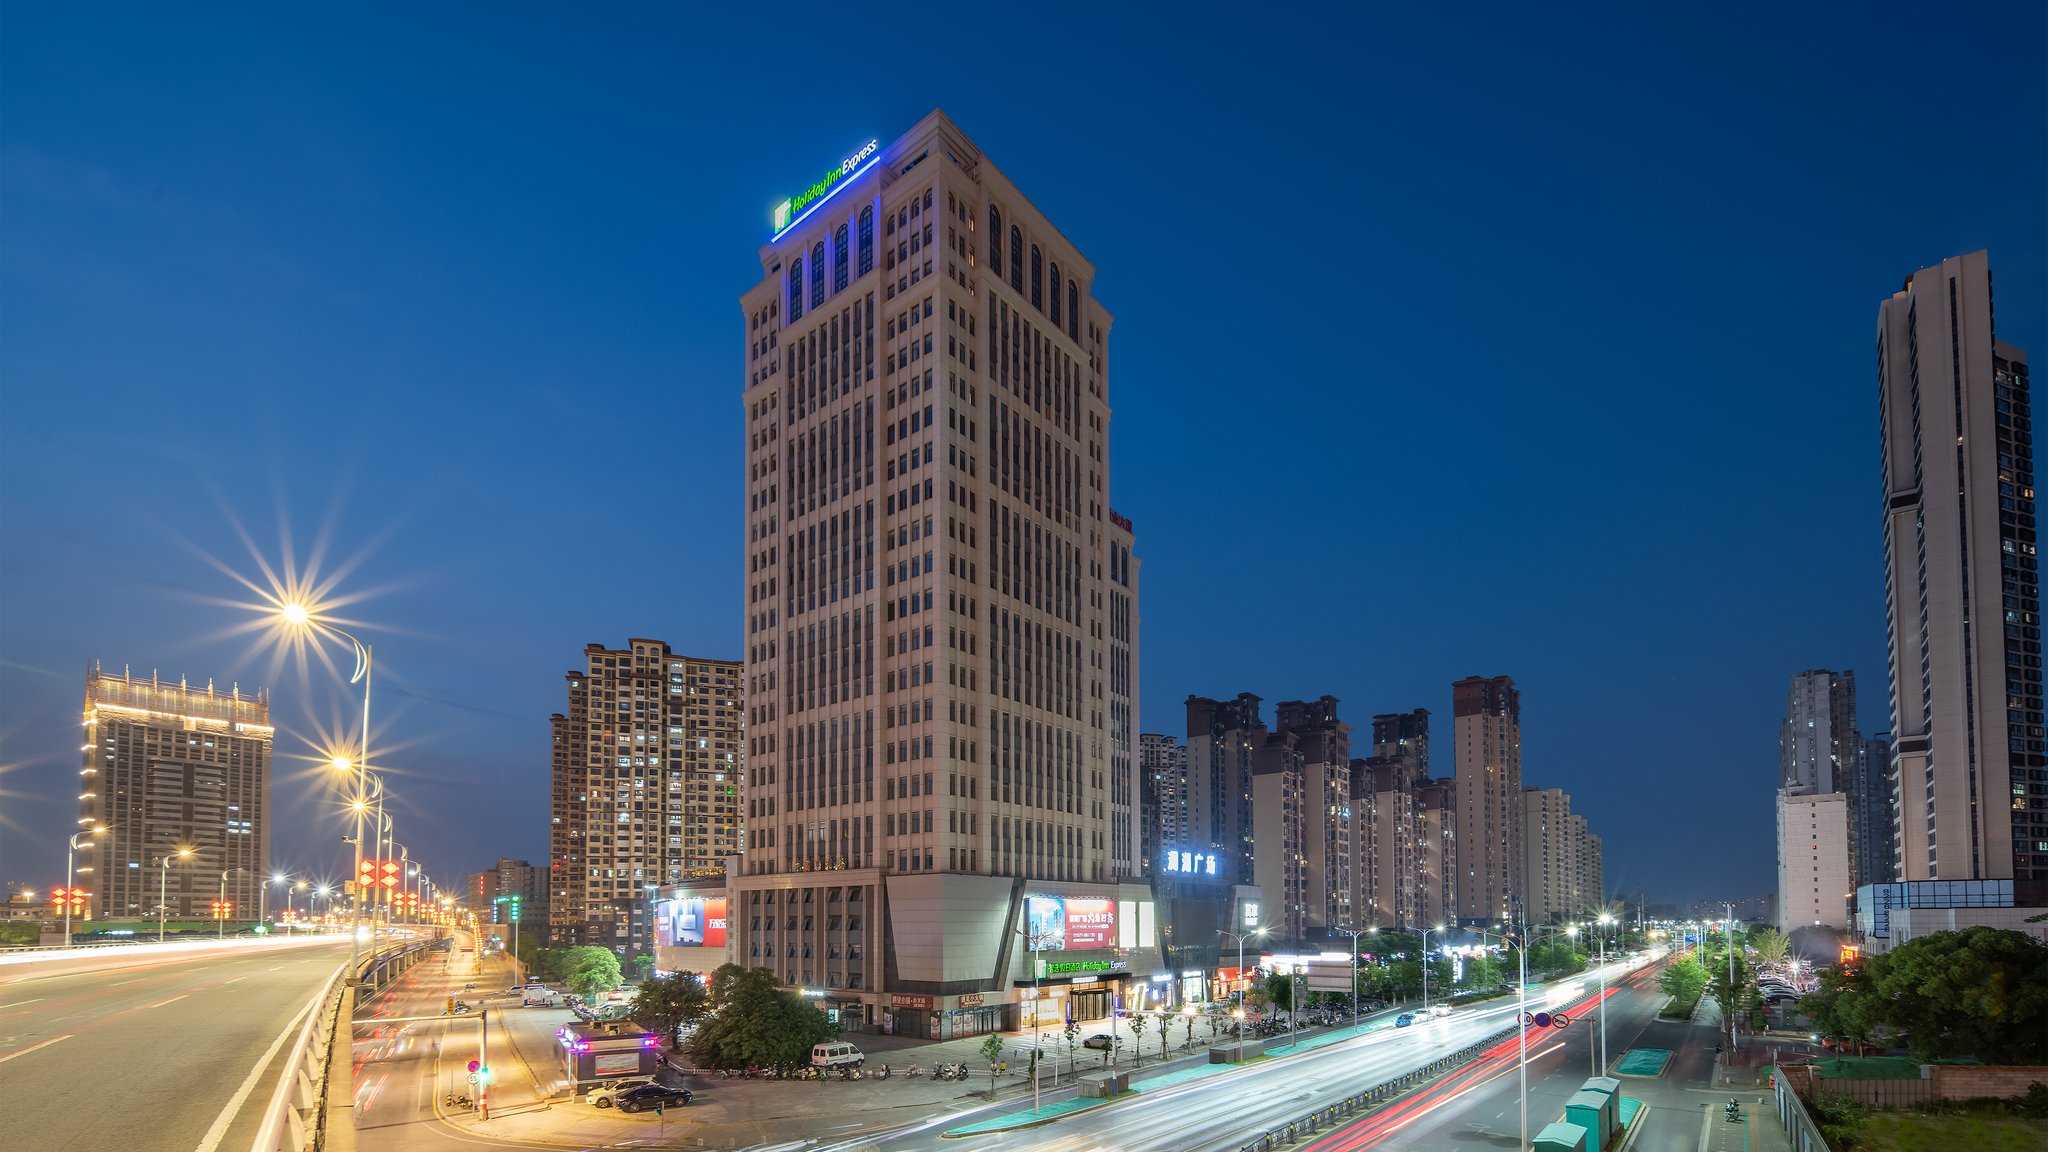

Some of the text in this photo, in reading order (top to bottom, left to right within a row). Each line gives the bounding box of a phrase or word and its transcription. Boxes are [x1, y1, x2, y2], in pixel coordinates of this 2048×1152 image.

[793, 139, 877, 213] Holiday Inn Express
[1110, 961, 1127, 969] Express
